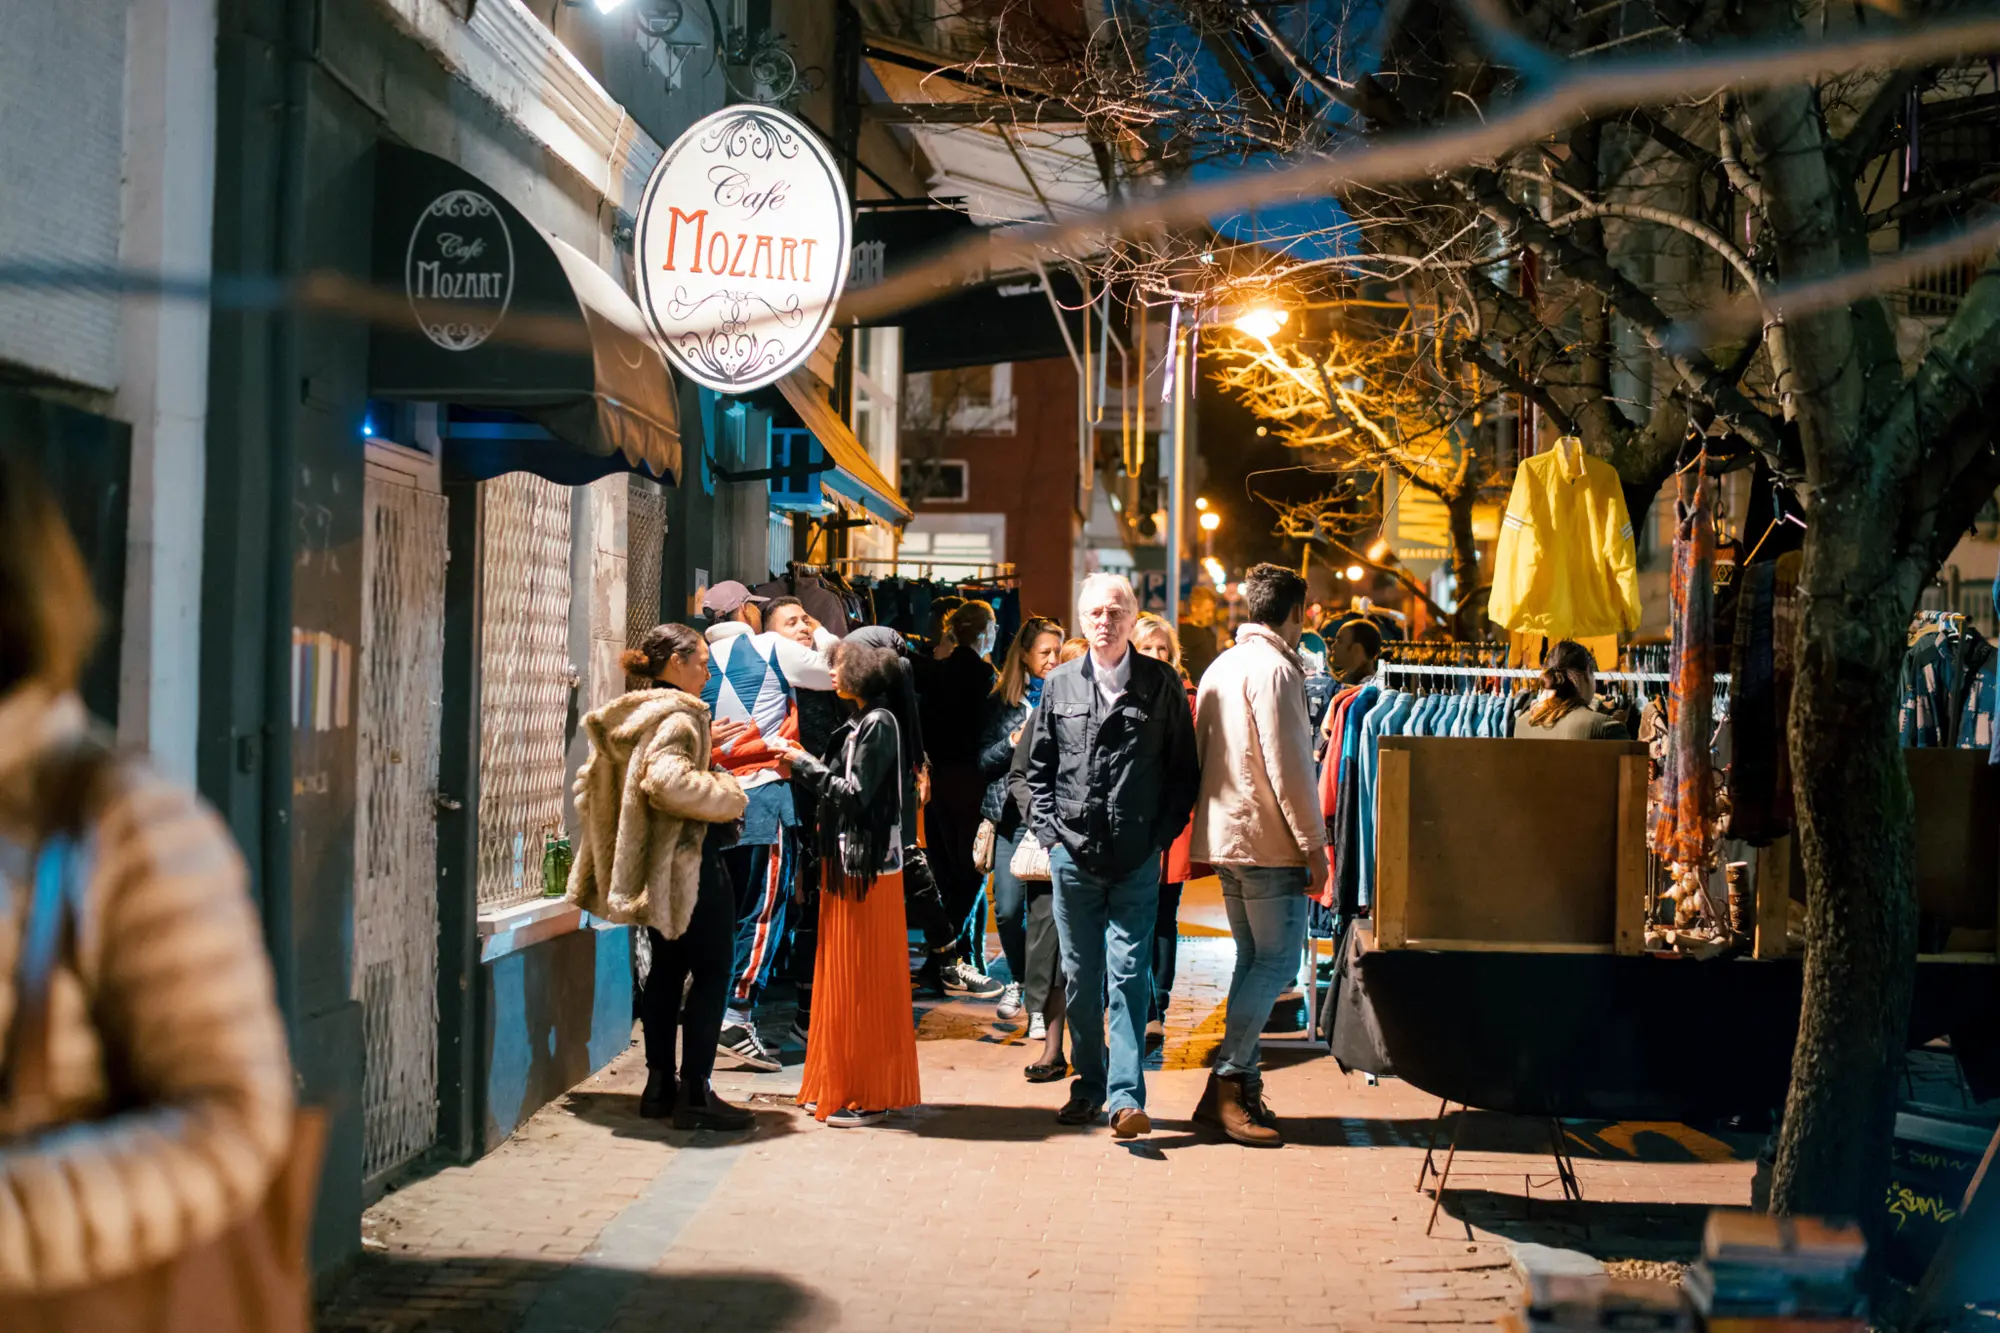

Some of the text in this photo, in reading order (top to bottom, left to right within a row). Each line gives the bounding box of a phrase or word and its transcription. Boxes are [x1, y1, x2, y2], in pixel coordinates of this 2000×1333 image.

[707, 165, 791, 221] Café
[437, 232, 488, 265] Café
[662, 206, 818, 282] MOZART
[416, 260, 503, 298] MOZART
[1399, 548, 1447, 559] MARKET
